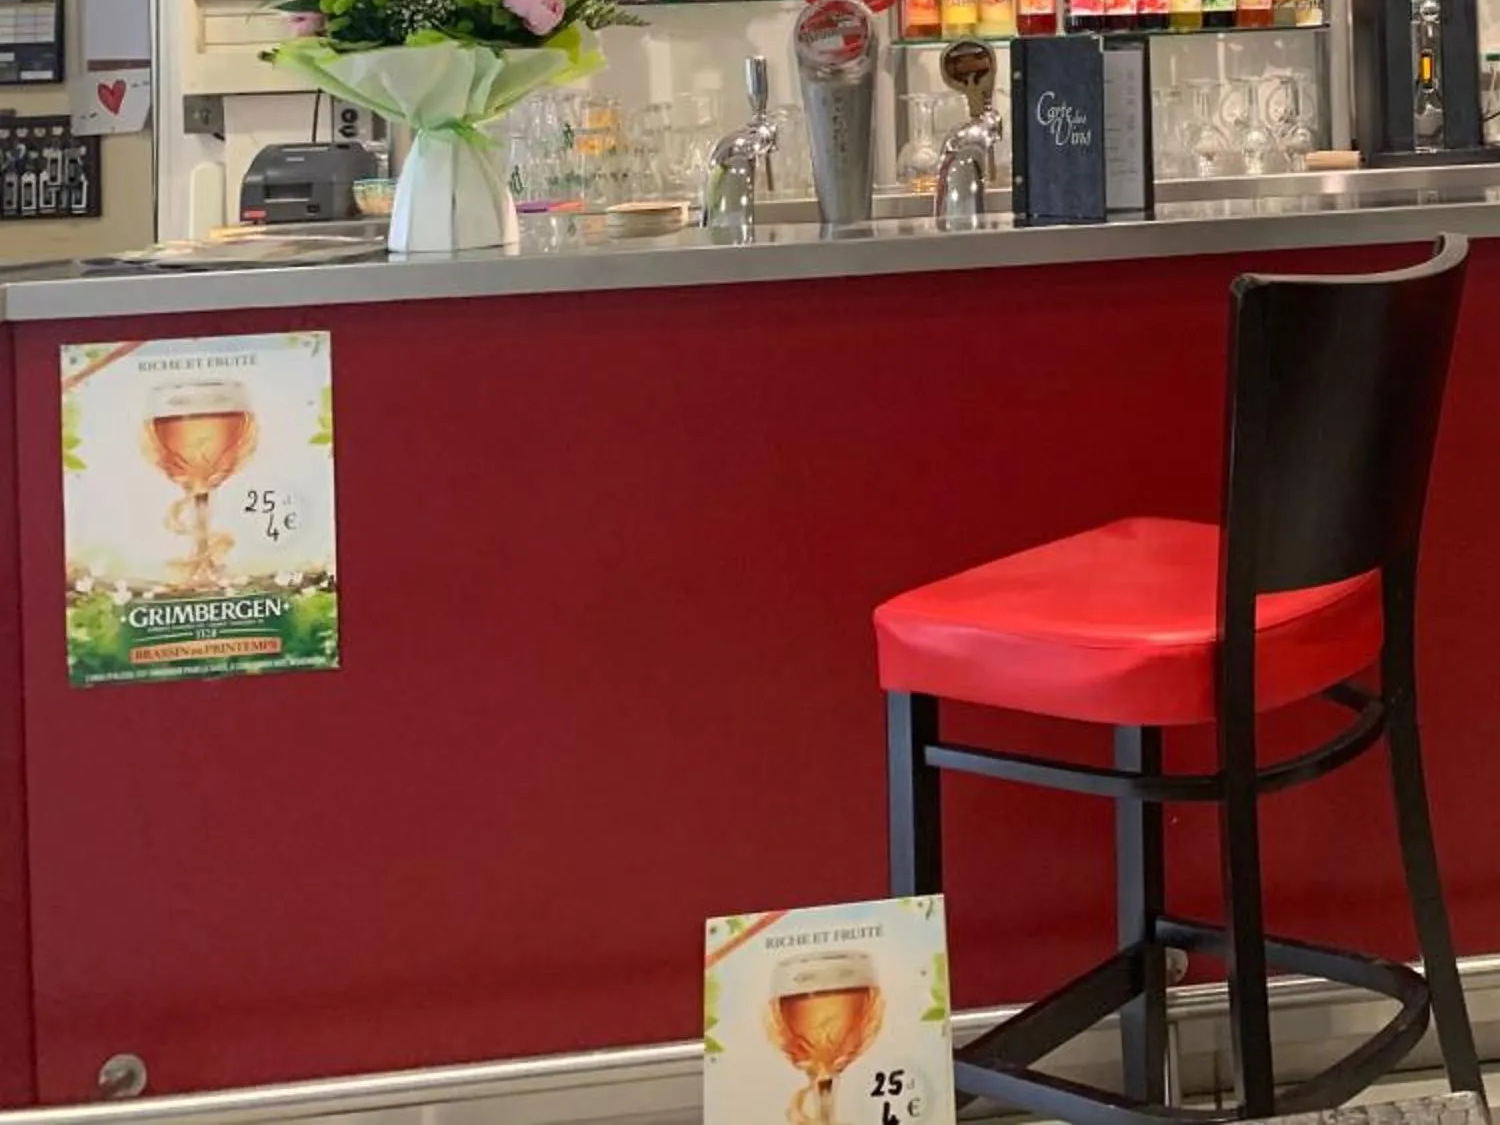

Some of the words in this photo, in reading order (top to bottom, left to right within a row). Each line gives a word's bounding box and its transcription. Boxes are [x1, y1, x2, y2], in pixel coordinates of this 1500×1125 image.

[245, 489, 275, 514] 25
[128, 598, 282, 628] GRIMBERGEN
[135, 647, 189, 661] BRASSIN
[204, 639, 278, 656] PRINTEMPS
[813, 931, 831, 945] ET
[871, 1069, 905, 1097] 25
